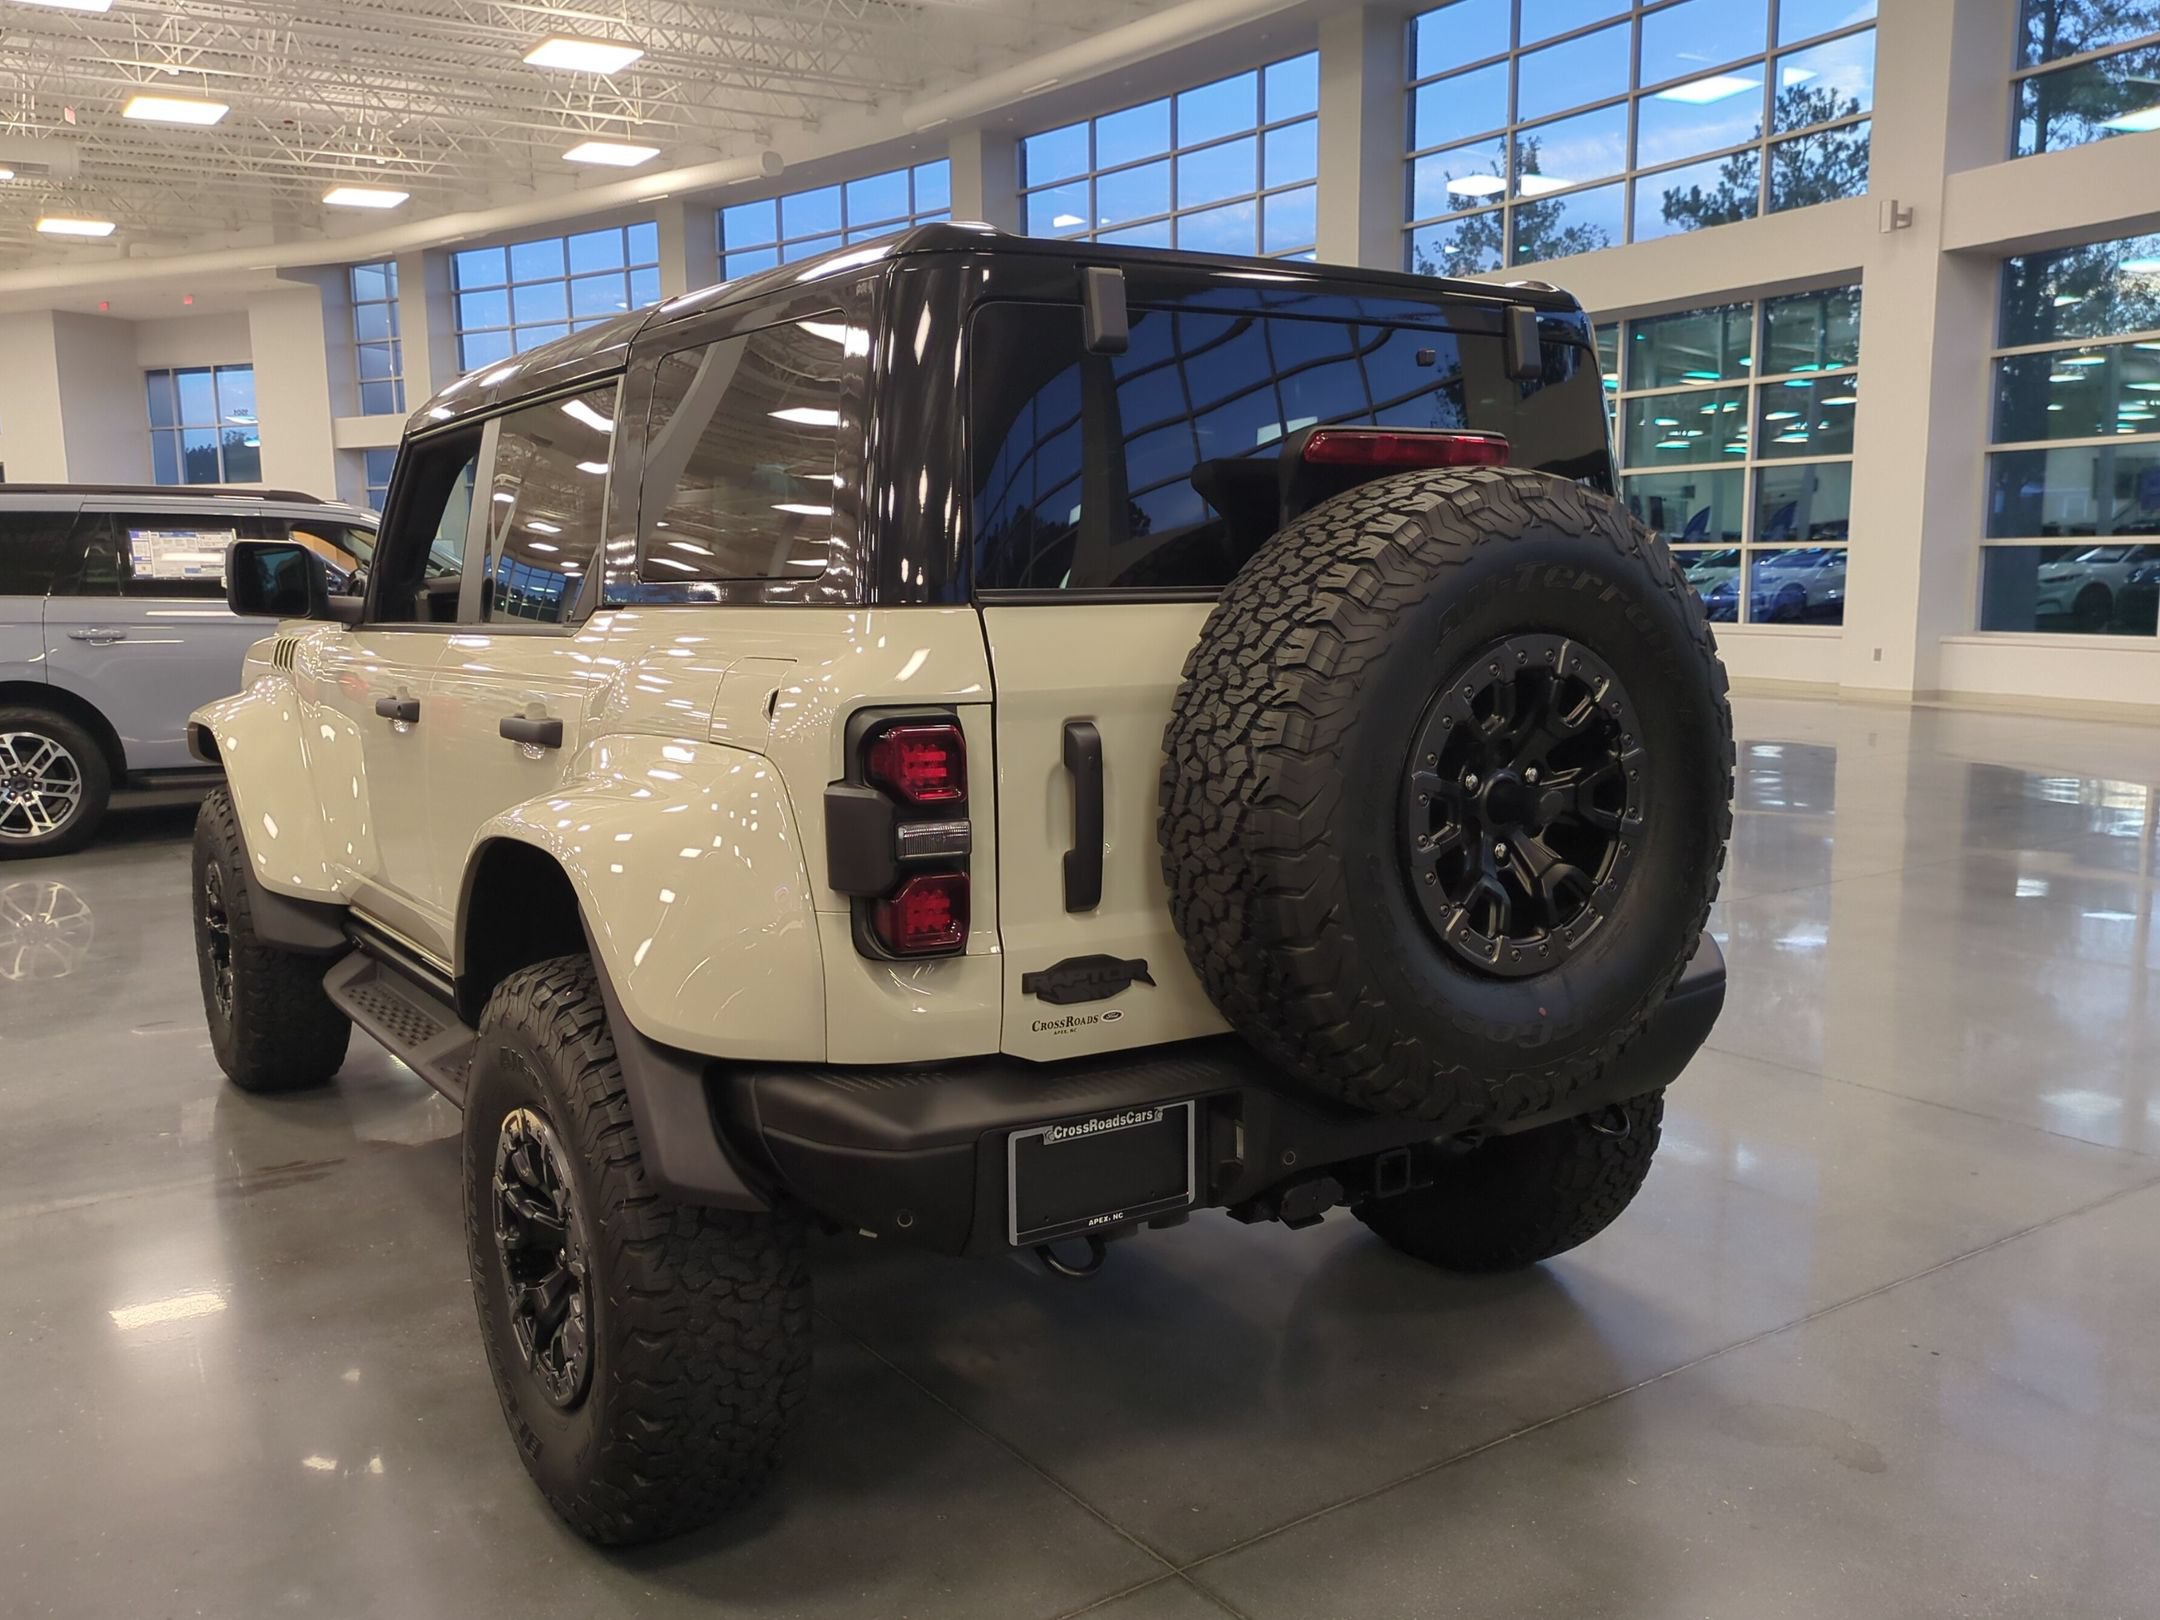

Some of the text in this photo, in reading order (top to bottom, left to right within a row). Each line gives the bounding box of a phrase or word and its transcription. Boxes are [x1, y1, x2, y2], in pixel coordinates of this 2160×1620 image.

[1024, 959, 1155, 994] RAPTOR
[1053, 1110, 1153, 1139] CrossRoadsCars
[1113, 1212, 1124, 1220] NC
